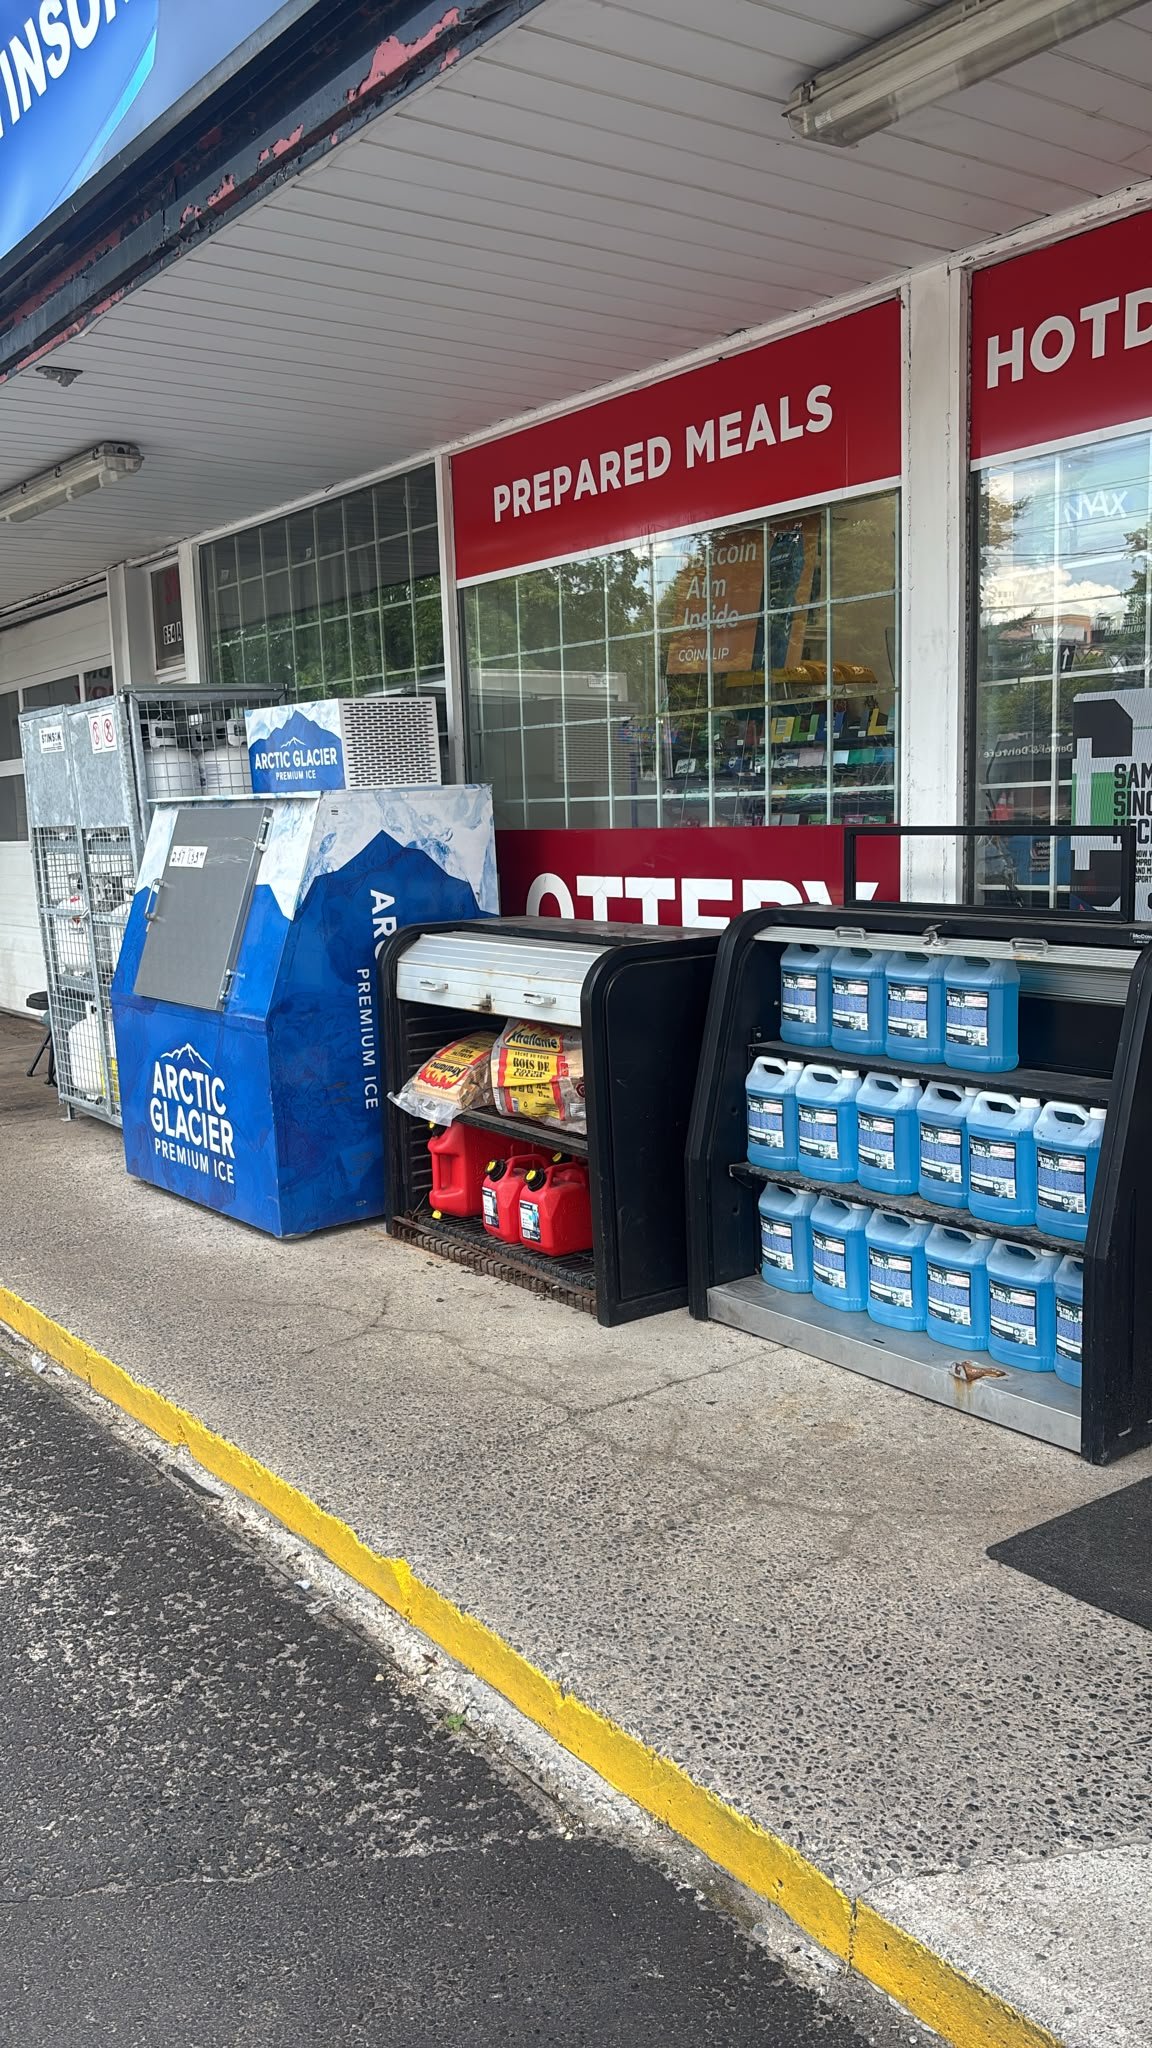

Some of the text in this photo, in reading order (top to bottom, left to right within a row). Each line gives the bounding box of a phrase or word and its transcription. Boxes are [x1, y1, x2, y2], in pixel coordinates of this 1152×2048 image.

[0, 0, 130, 139] INSO
[986, 287, 1152, 390] HOTD
[493, 384, 833, 523] PREPARED MEALS
[691, 537, 757, 568] tcoin
[686, 575, 727, 600] Atm
[684, 604, 739, 631] Inside
[678, 647, 730, 662] COINLIP
[255, 747, 338, 770] ARCTIC GLACIER
[275, 769, 317, 781] PREMIUM ICE
[1136, 858, 1152, 867] MPRO
[526, 872, 879, 929] OTTE
[357, 968, 379, 1110] PREMIUM ICE
[506, 1028, 557, 1049] Xtraflame
[513, 1057, 550, 1073] BOIS DE
[153, 1061, 227, 1116] ARCTIC
[150, 1097, 236, 1159] GLACIER
[154, 1137, 235, 1185] PREMIUM ICE
